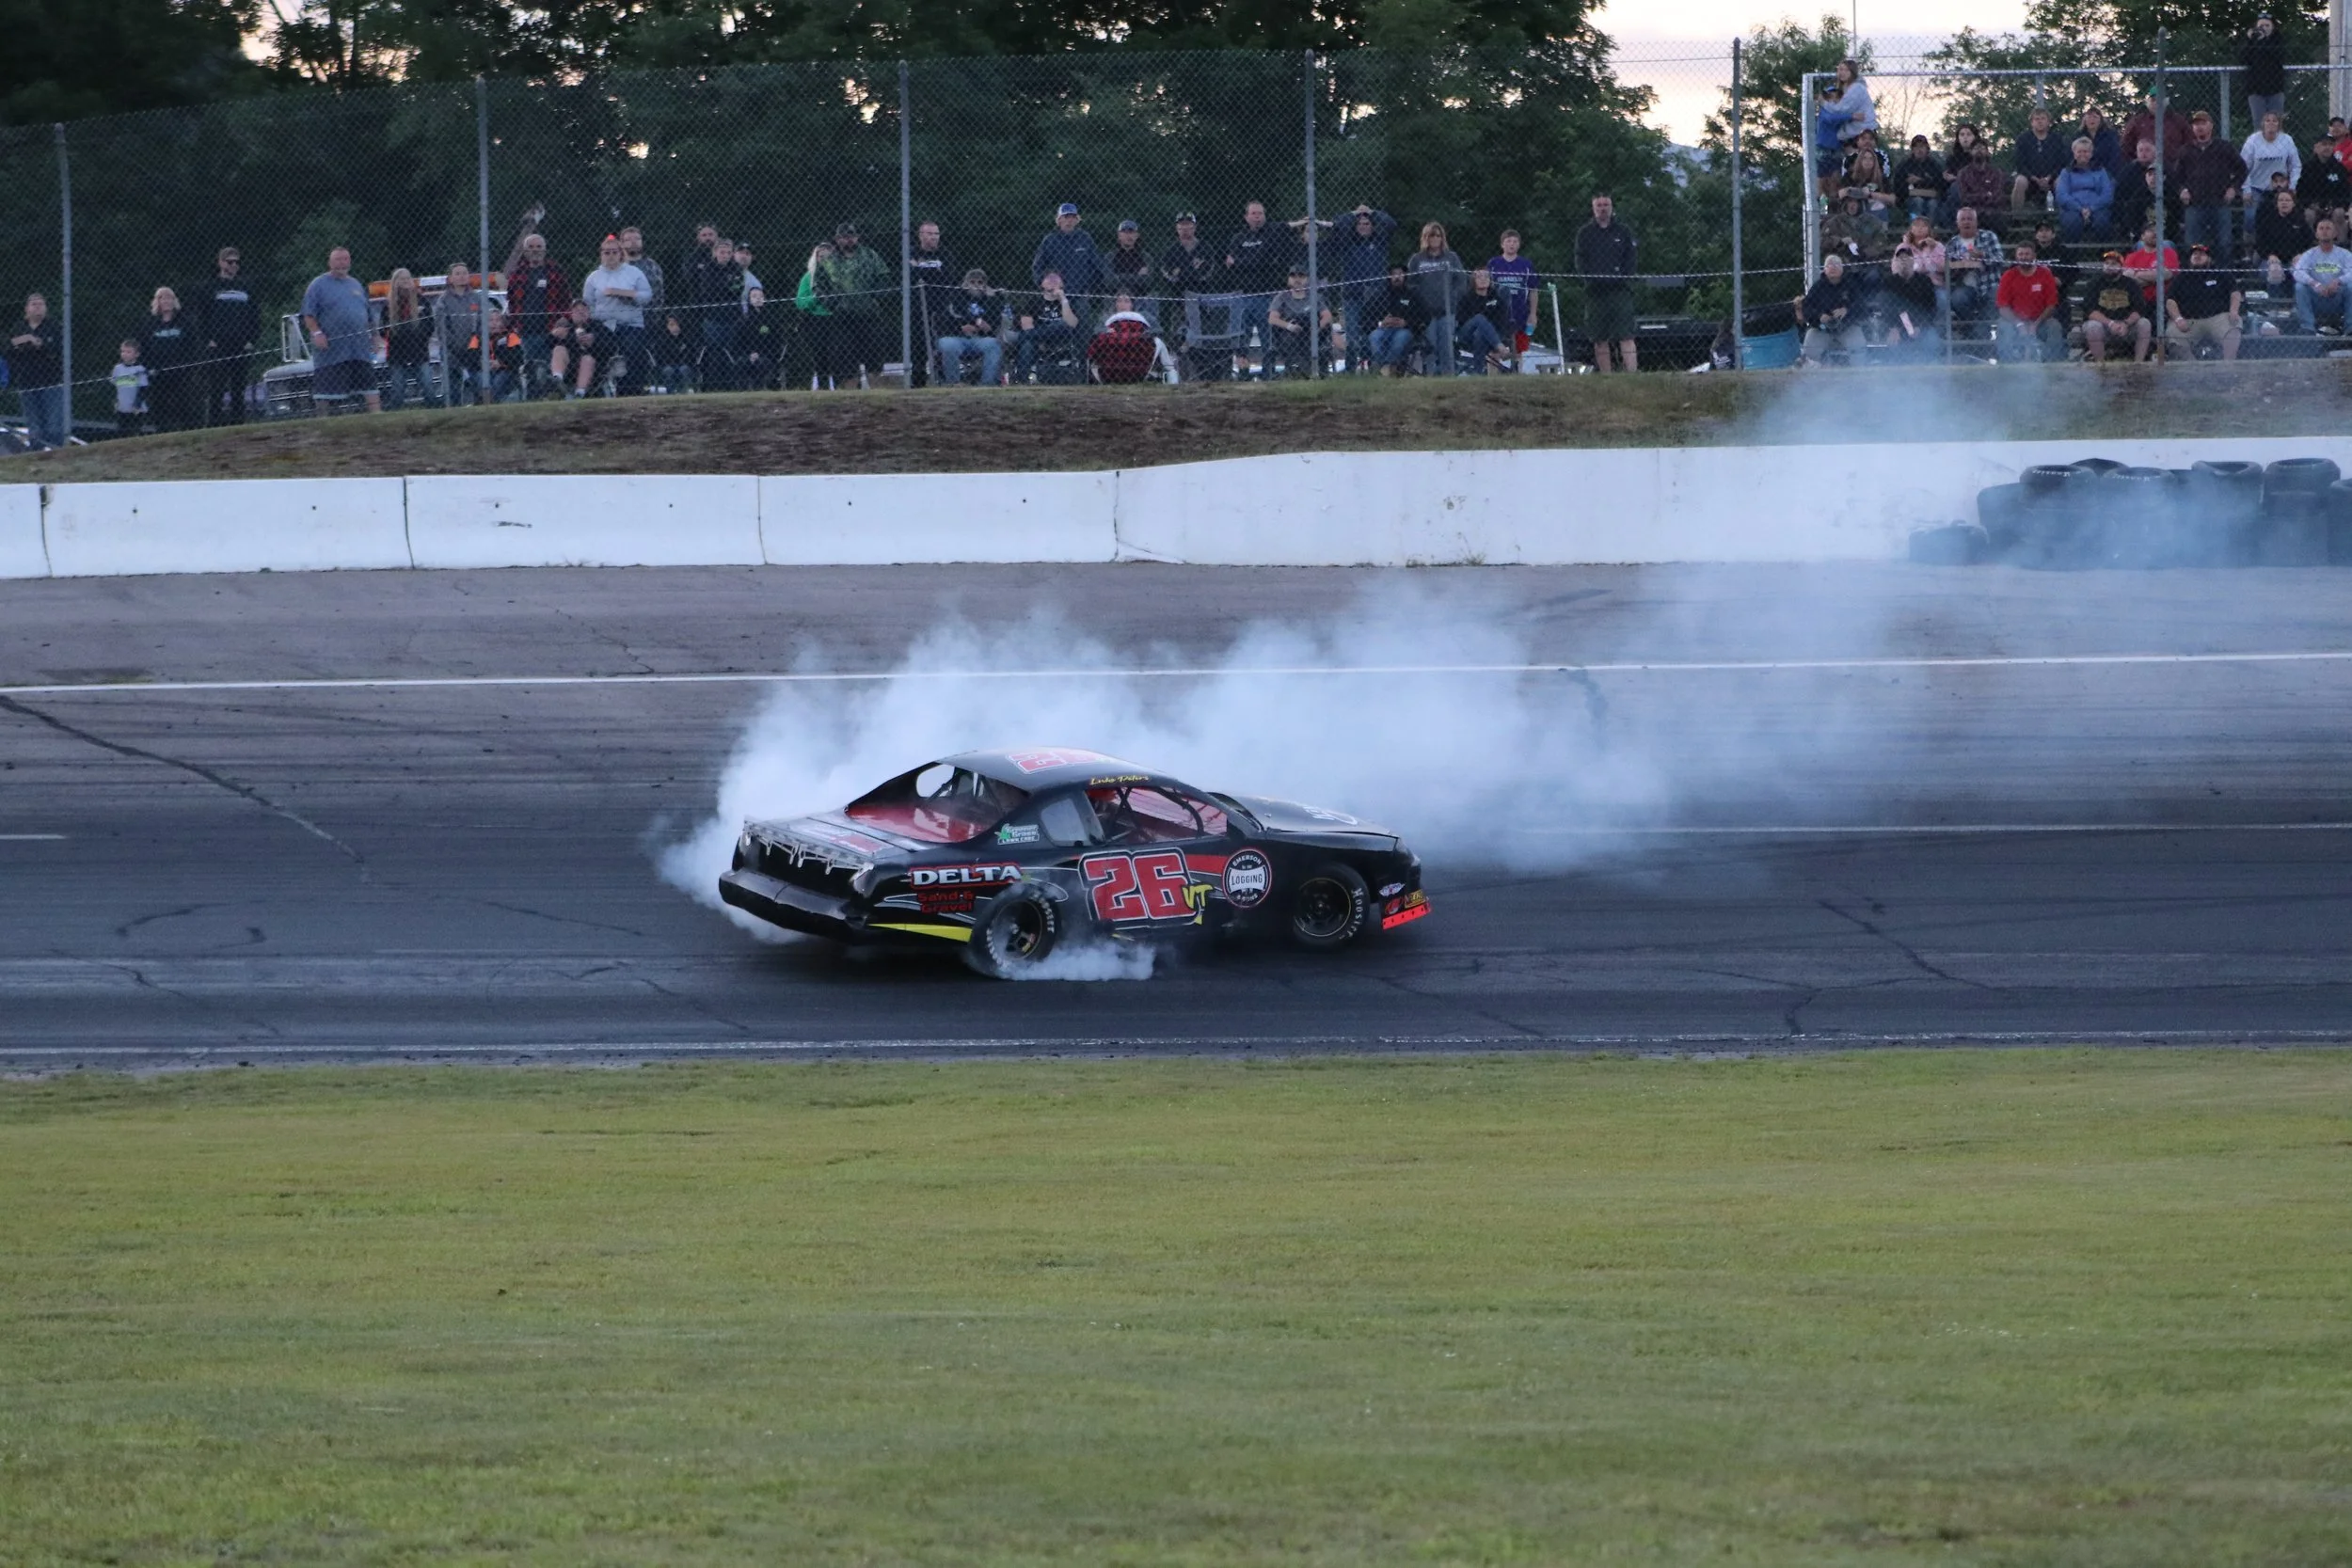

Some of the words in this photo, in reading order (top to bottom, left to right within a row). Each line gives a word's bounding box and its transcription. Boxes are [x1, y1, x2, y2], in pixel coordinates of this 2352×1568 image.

[1232, 855, 1262, 866] EMERSON
[913, 864, 1023, 886] DELTA
[1232, 873, 1263, 886] LOGGING
[1083, 852, 1197, 922] 26
[918, 891, 958, 903] Sand
[1183, 884, 1215, 910] VT
[921, 901, 973, 914] Gravel
